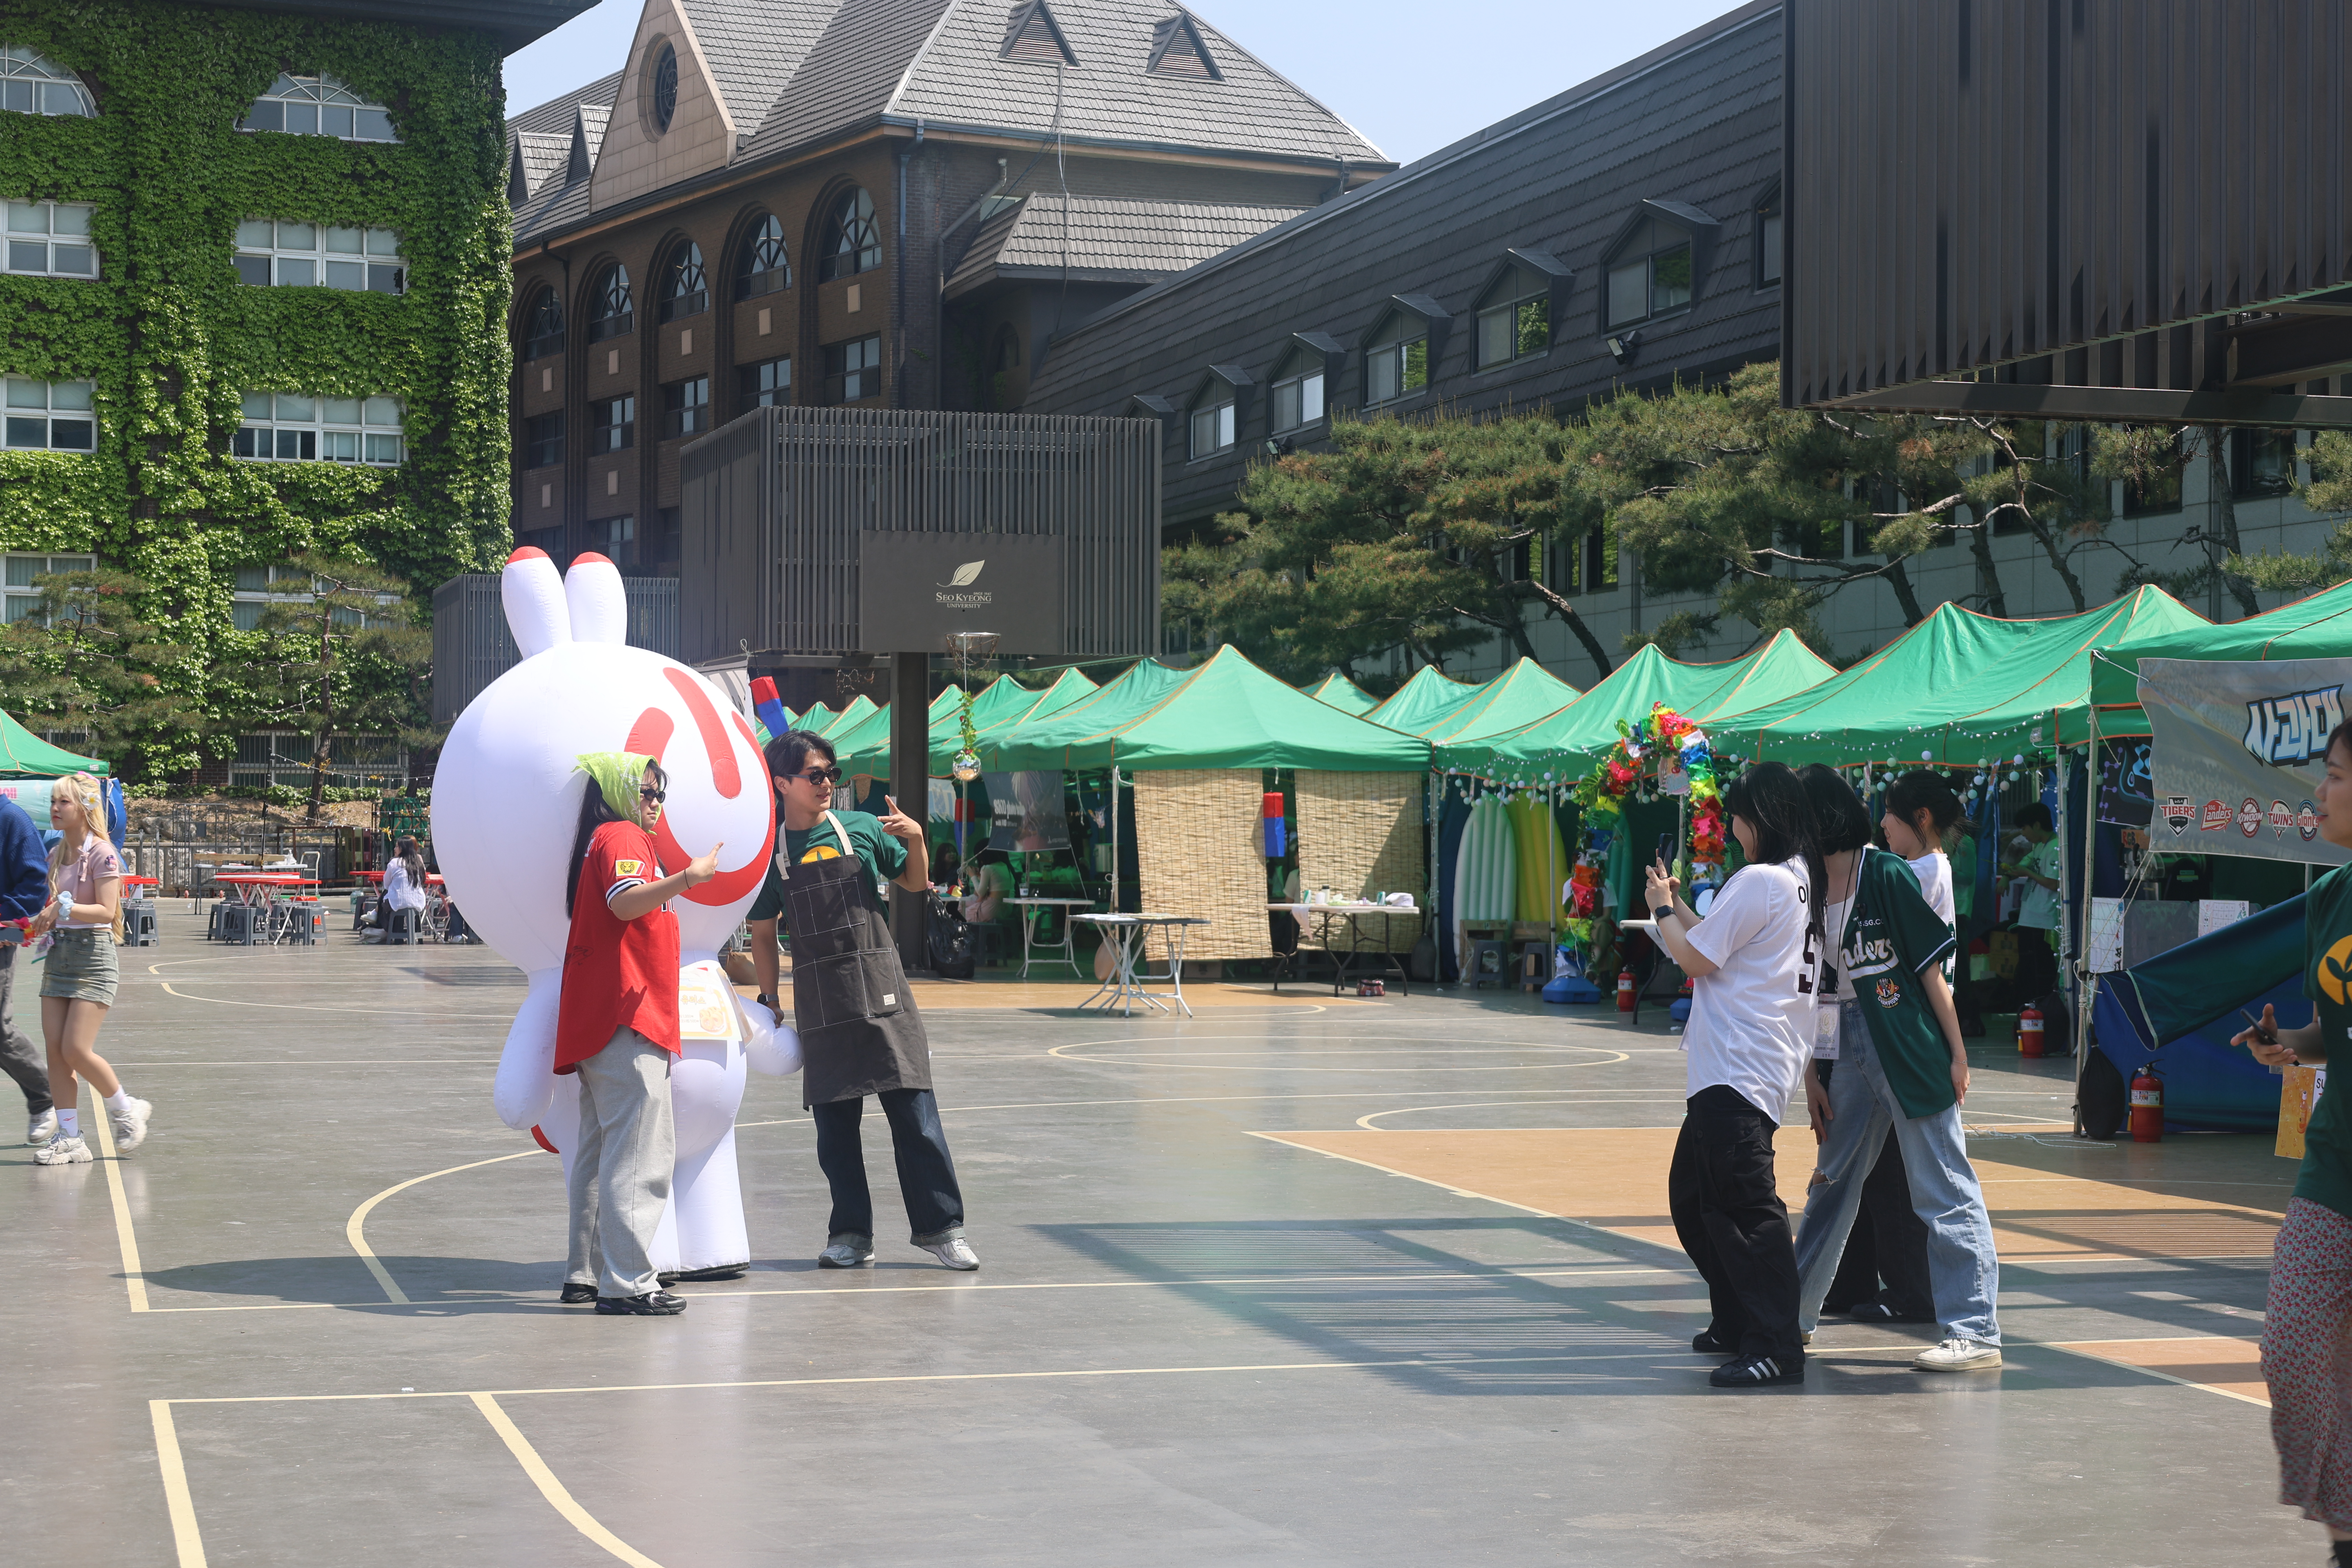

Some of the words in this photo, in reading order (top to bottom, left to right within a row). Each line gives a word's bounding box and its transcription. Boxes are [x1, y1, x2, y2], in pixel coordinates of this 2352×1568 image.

[2160, 806, 2196, 818] TIGERS
[2201, 806, 2231, 828] Landers
[2236, 812, 2264, 824] KIWOOM
[2267, 813, 2293, 826] TWINS
[1877, 993, 1900, 1006] CHAMPIONS
